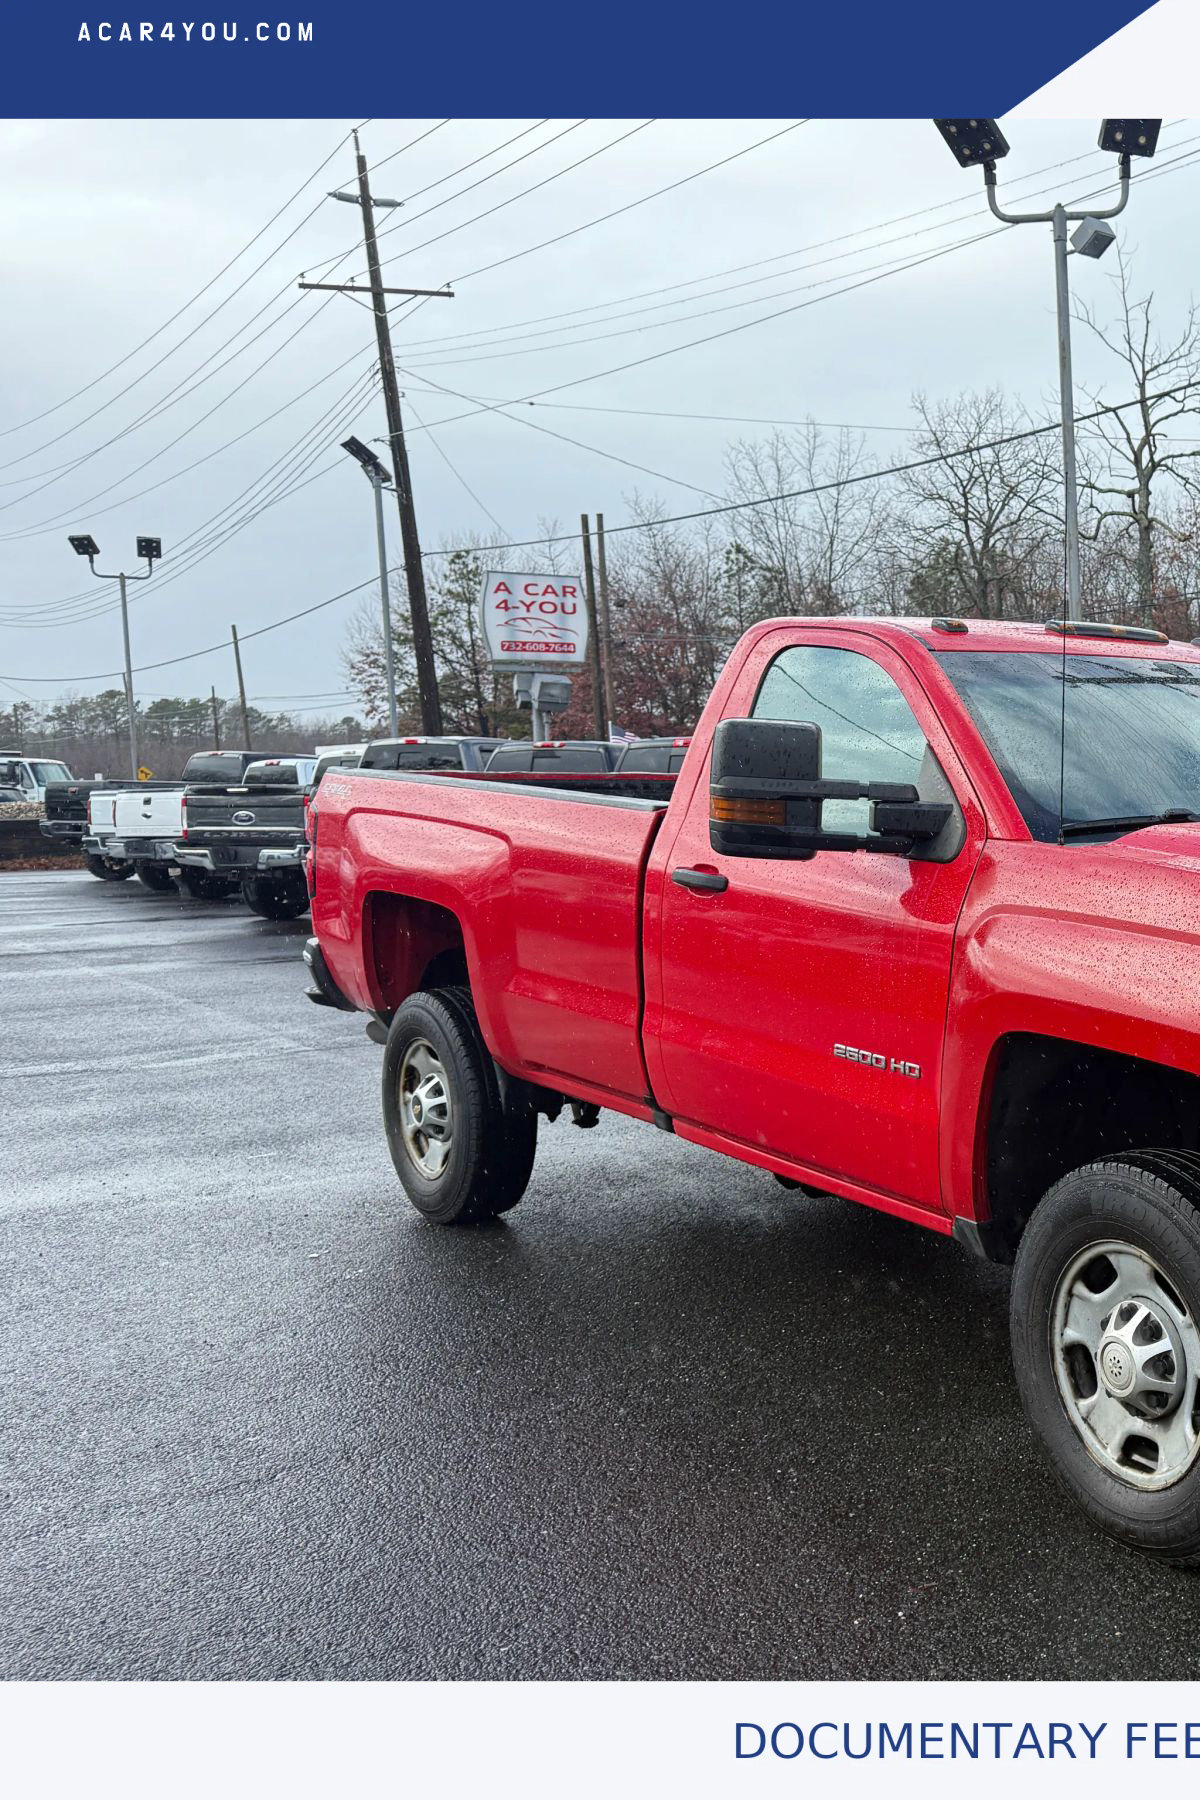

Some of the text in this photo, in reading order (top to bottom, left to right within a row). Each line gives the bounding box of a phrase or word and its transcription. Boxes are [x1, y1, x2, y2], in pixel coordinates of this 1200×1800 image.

[493, 581, 577, 598] A CAR
[495, 599, 577, 615] 4-YOU
